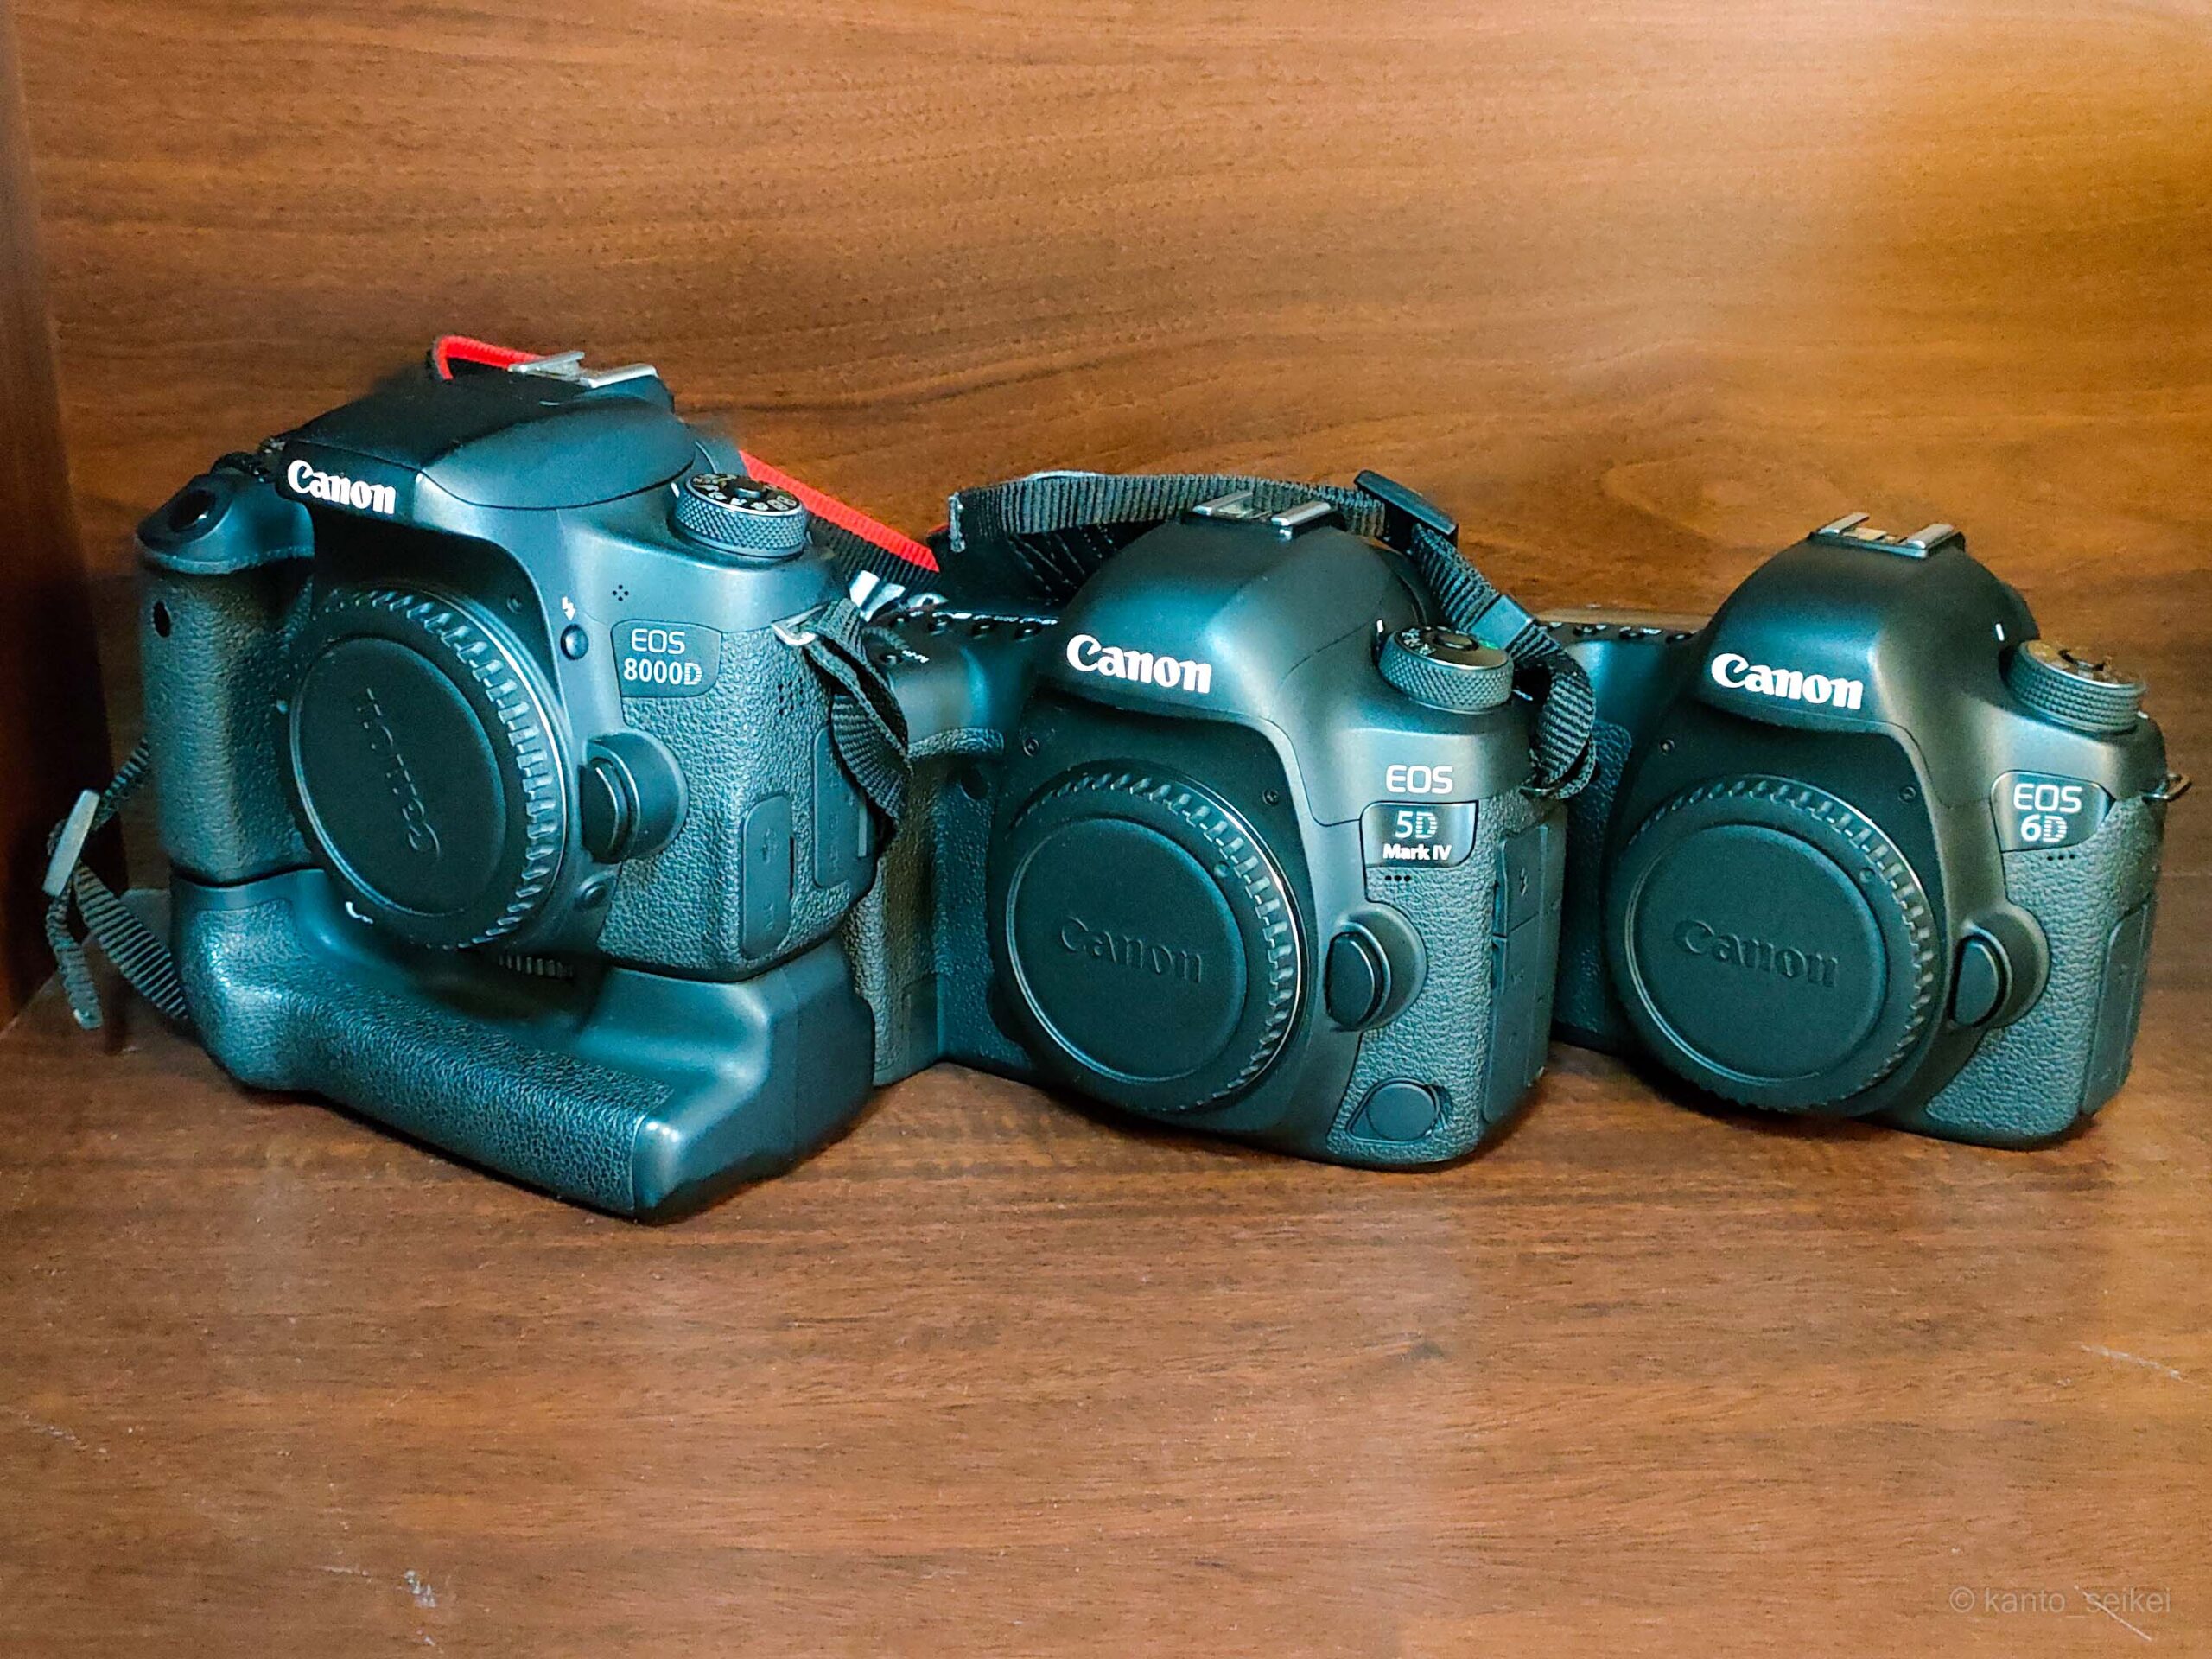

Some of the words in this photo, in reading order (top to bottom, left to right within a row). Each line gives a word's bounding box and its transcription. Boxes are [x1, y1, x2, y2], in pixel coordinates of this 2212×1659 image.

[287, 459, 396, 514] Canon
[631, 628, 685, 655] EOS
[623, 658, 702, 686] 8000D
[1066, 634, 1211, 693] Canon
[1711, 653, 1863, 709] Canon
[1386, 764, 1453, 794] EOS
[2012, 783, 2082, 813] EOS
[1395, 810, 1438, 839] 5D
[2020, 814, 2067, 842] 6D
[1382, 842, 1429, 861] Mark
[1432, 844, 1452, 861] IV
[1060, 918, 1202, 983] Canon
[1675, 919, 1839, 987] Canon
